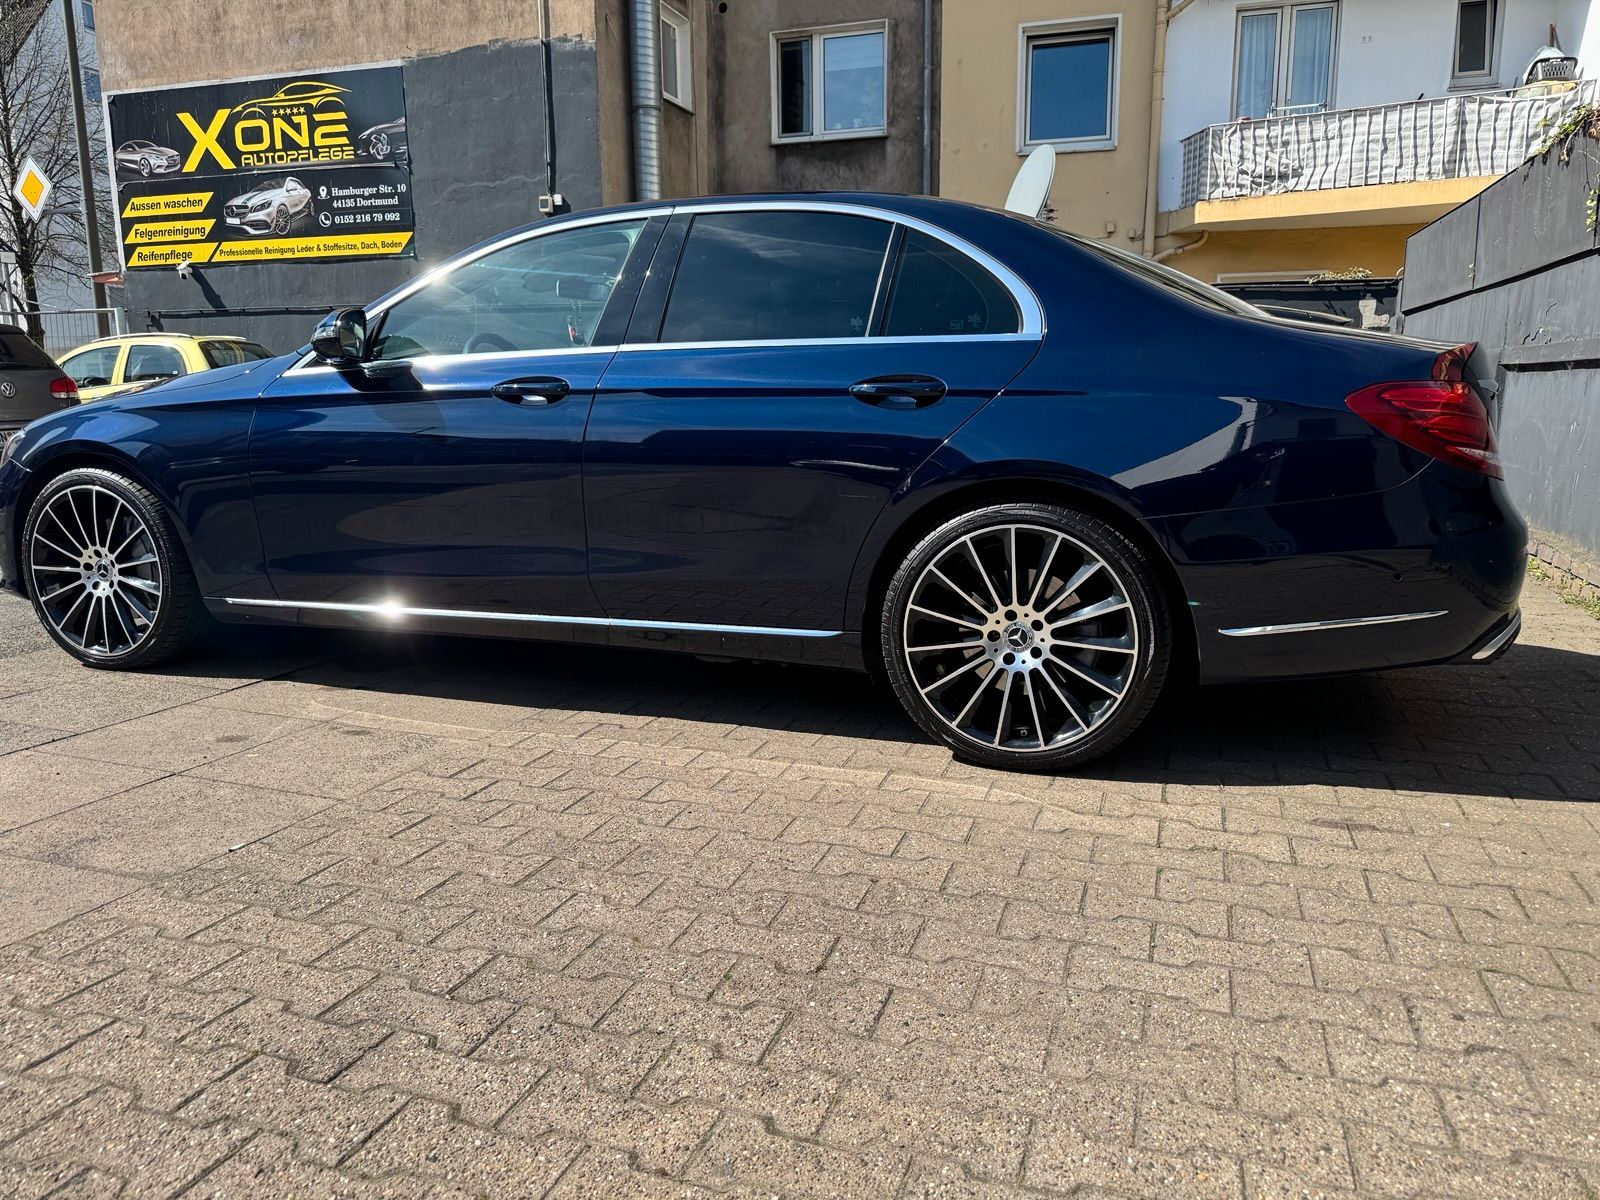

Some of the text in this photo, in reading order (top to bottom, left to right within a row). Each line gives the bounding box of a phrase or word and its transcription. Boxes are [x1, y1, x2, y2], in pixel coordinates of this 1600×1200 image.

[175, 108, 350, 173] X ONE
[241, 146, 355, 167] AUTOPFLEGE
[331, 183, 407, 197] Hamburger Str. 10
[129, 198, 203, 212] Aussen waschen
[332, 195, 399, 209] 44135 Dortmund
[334, 212, 400, 224] 0152 216 79 092
[134, 226, 206, 240] Felgenreinigung
[219, 239, 402, 257] Professionelle Reinigung Leder & Stoffesitze, Dach, Boden
[137, 249, 193, 262] Reifenpflege
